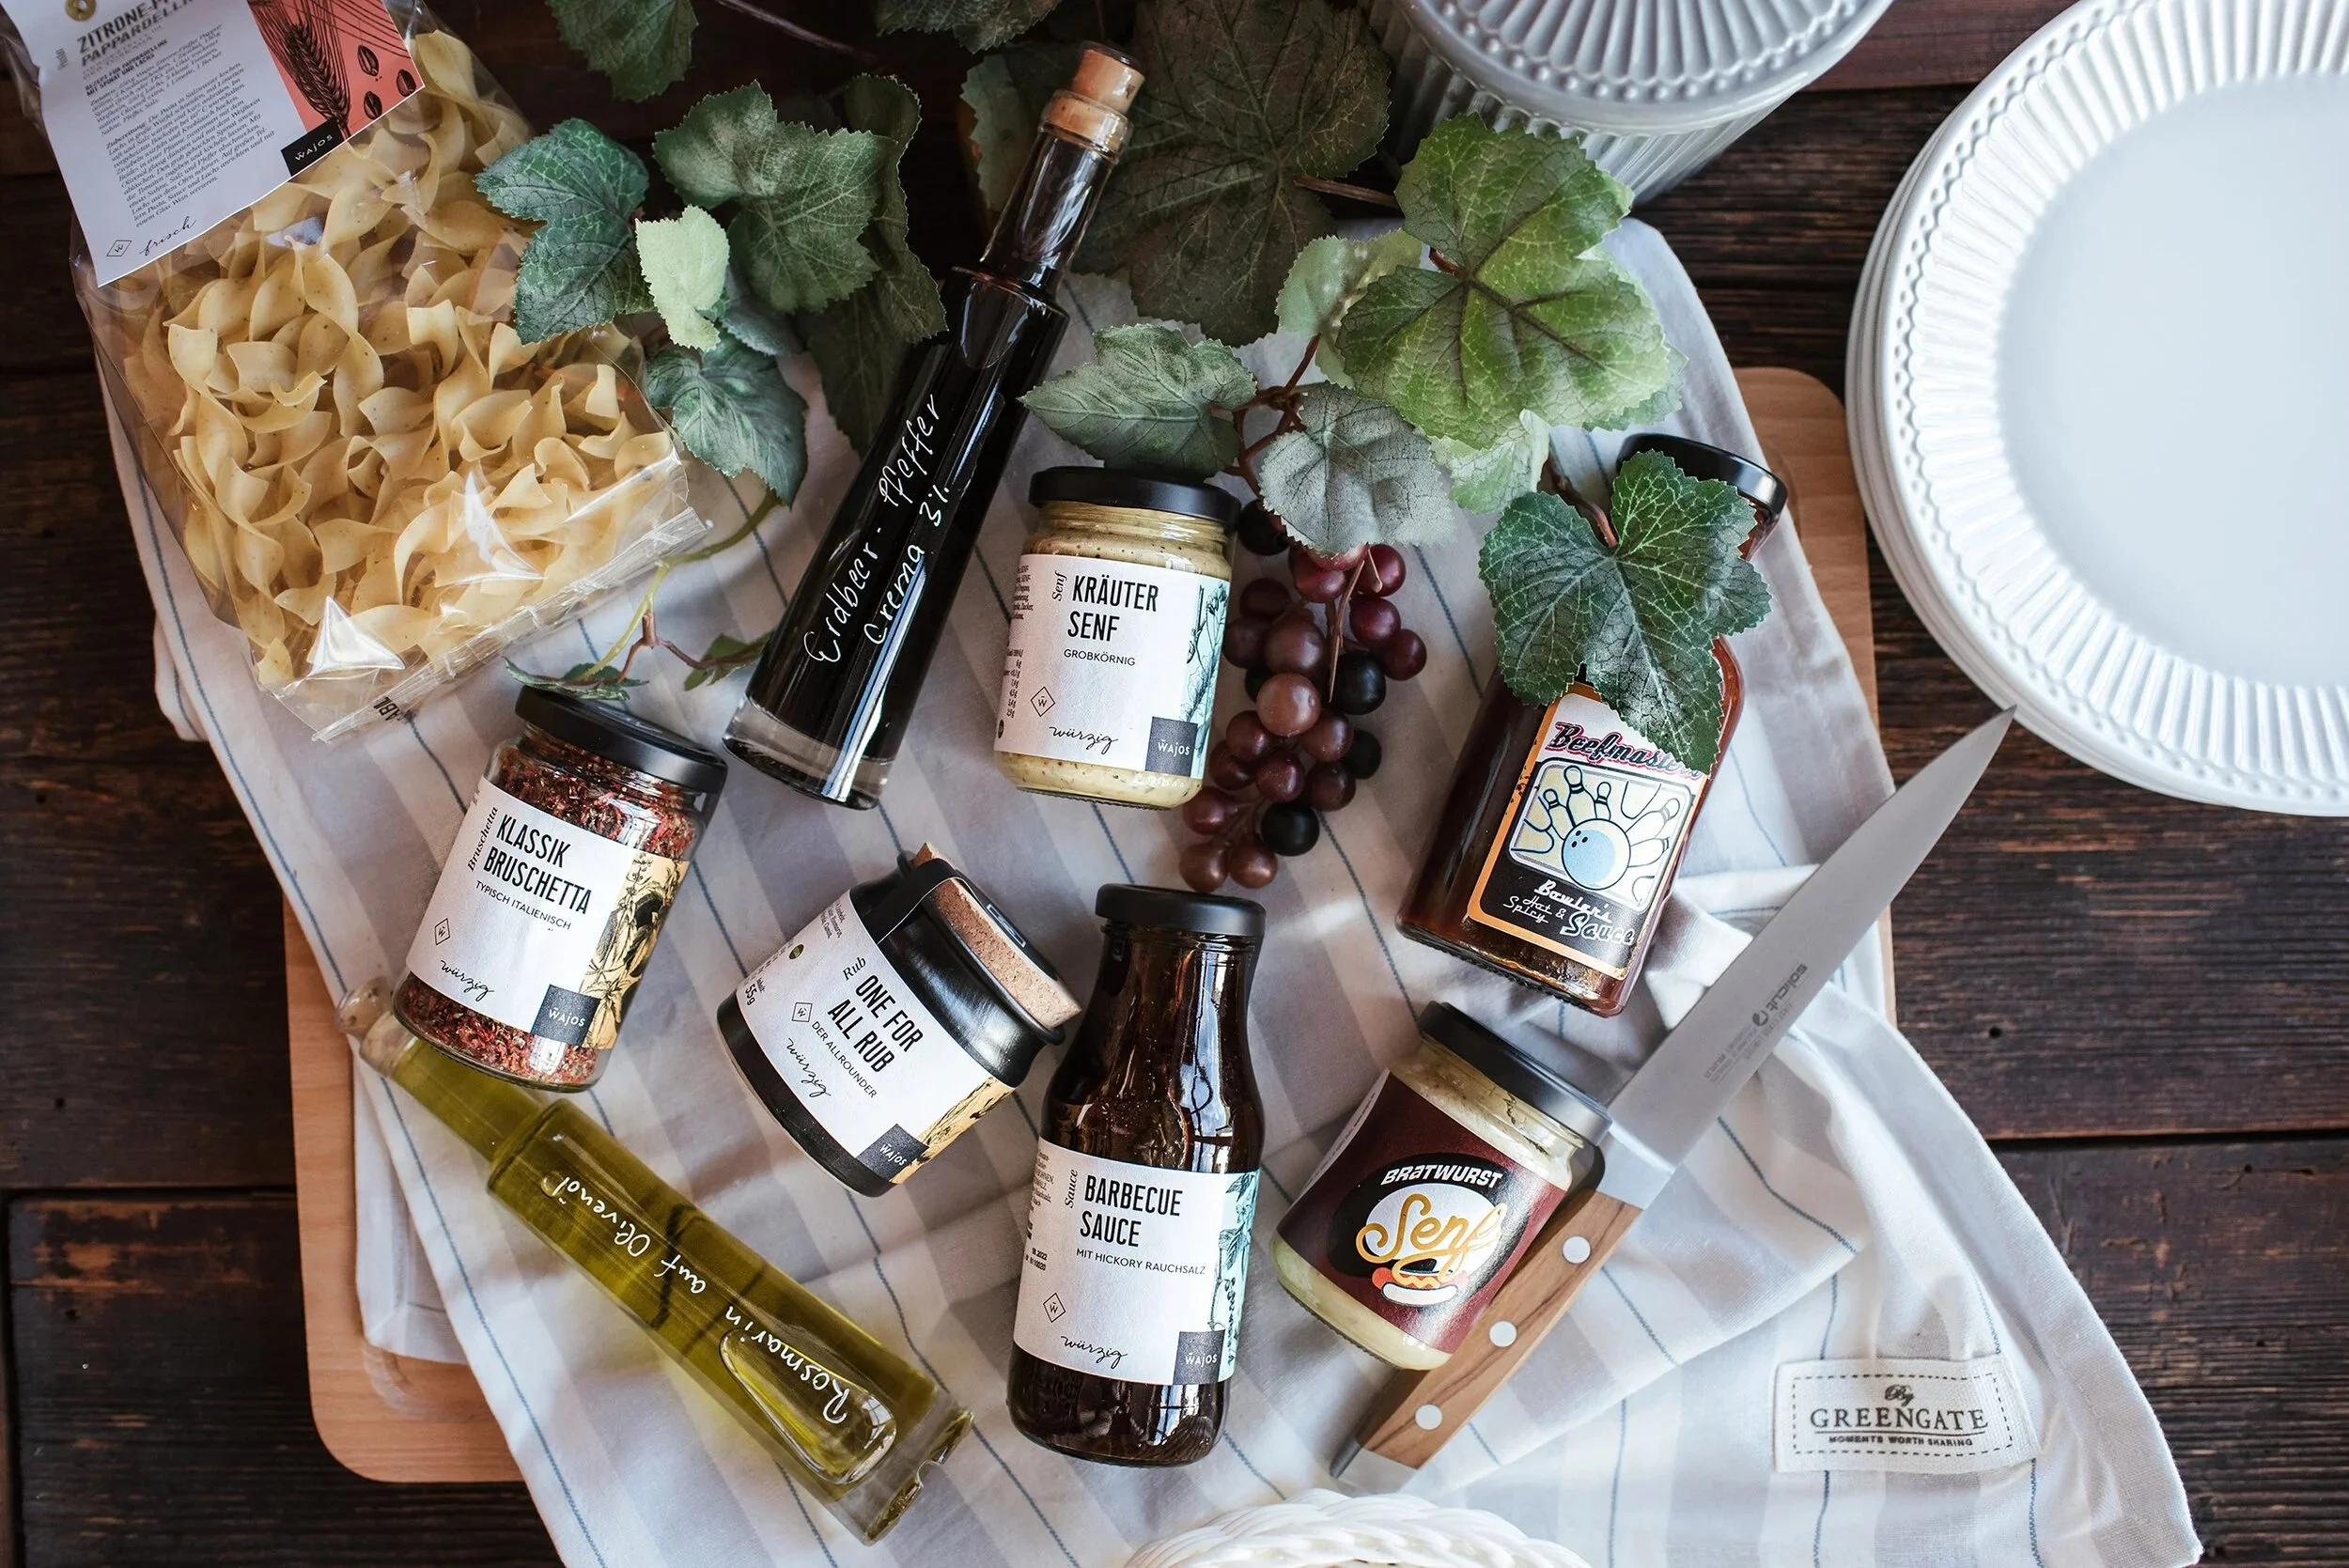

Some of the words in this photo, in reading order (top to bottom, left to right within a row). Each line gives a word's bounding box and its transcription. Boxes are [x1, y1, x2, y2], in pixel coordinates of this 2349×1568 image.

[139, 216, 196, 256] frisch
[804, 541, 879, 663] Erdbeer
[879, 394, 941, 506] Pfeffer
[864, 544, 926, 646] Crema
[1052, 571, 1068, 601] Senf
[1072, 574, 1159, 613] KRÄUTER
[1067, 611, 1120, 642] SENF
[1064, 648, 1136, 666] GROBKÖRNIG
[1049, 726, 1119, 754] würzig
[467, 806, 499, 873] Bruschetta
[496, 814, 571, 869] KLASSIK
[483, 846, 593, 915] BRUSCHETTA
[475, 880, 511, 907] TYPISCH
[511, 899, 572, 931] ITALIENISCH
[1503, 895, 1549, 924] Spicy
[1522, 895, 1553, 915] Hot
[1555, 908, 1565, 920] &
[1560, 910, 1635, 945] Sauce
[440, 959, 495, 1001] würzig
[842, 956, 867, 982] Rub
[855, 974, 890, 1019] ONE
[882, 1009, 925, 1053] FOR
[827, 999, 860, 1041] ALL
[856, 1030, 895, 1074] RUB
[780, 1037, 832, 1099] würzig
[811, 1020, 829, 1039] DER
[825, 1034, 878, 1098] ALLROUNDER
[1065, 1169, 1079, 1209] Sauce
[1084, 1174, 1184, 1217] BARBECUE
[1080, 1210, 1142, 1247] SAUCE
[1355, 1193, 1507, 1285] Senf
[653, 1255, 708, 1295] auf
[1076, 1248, 1093, 1260] MIT
[1096, 1252, 1143, 1269] HICKORY
[1145, 1262, 1206, 1275] RAUCHSALZ
[723, 1304, 848, 1425] Rosmarin
[1060, 1335, 1128, 1369] würzig
[1884, 1384, 1915, 1406] By
[1810, 1407, 1988, 1430] GREENGATE
[1828, 1435, 1884, 1444] MOMENTS
[1889, 1436, 1924, 1445] WORTH
[1928, 1437, 1973, 1447] SHARING
